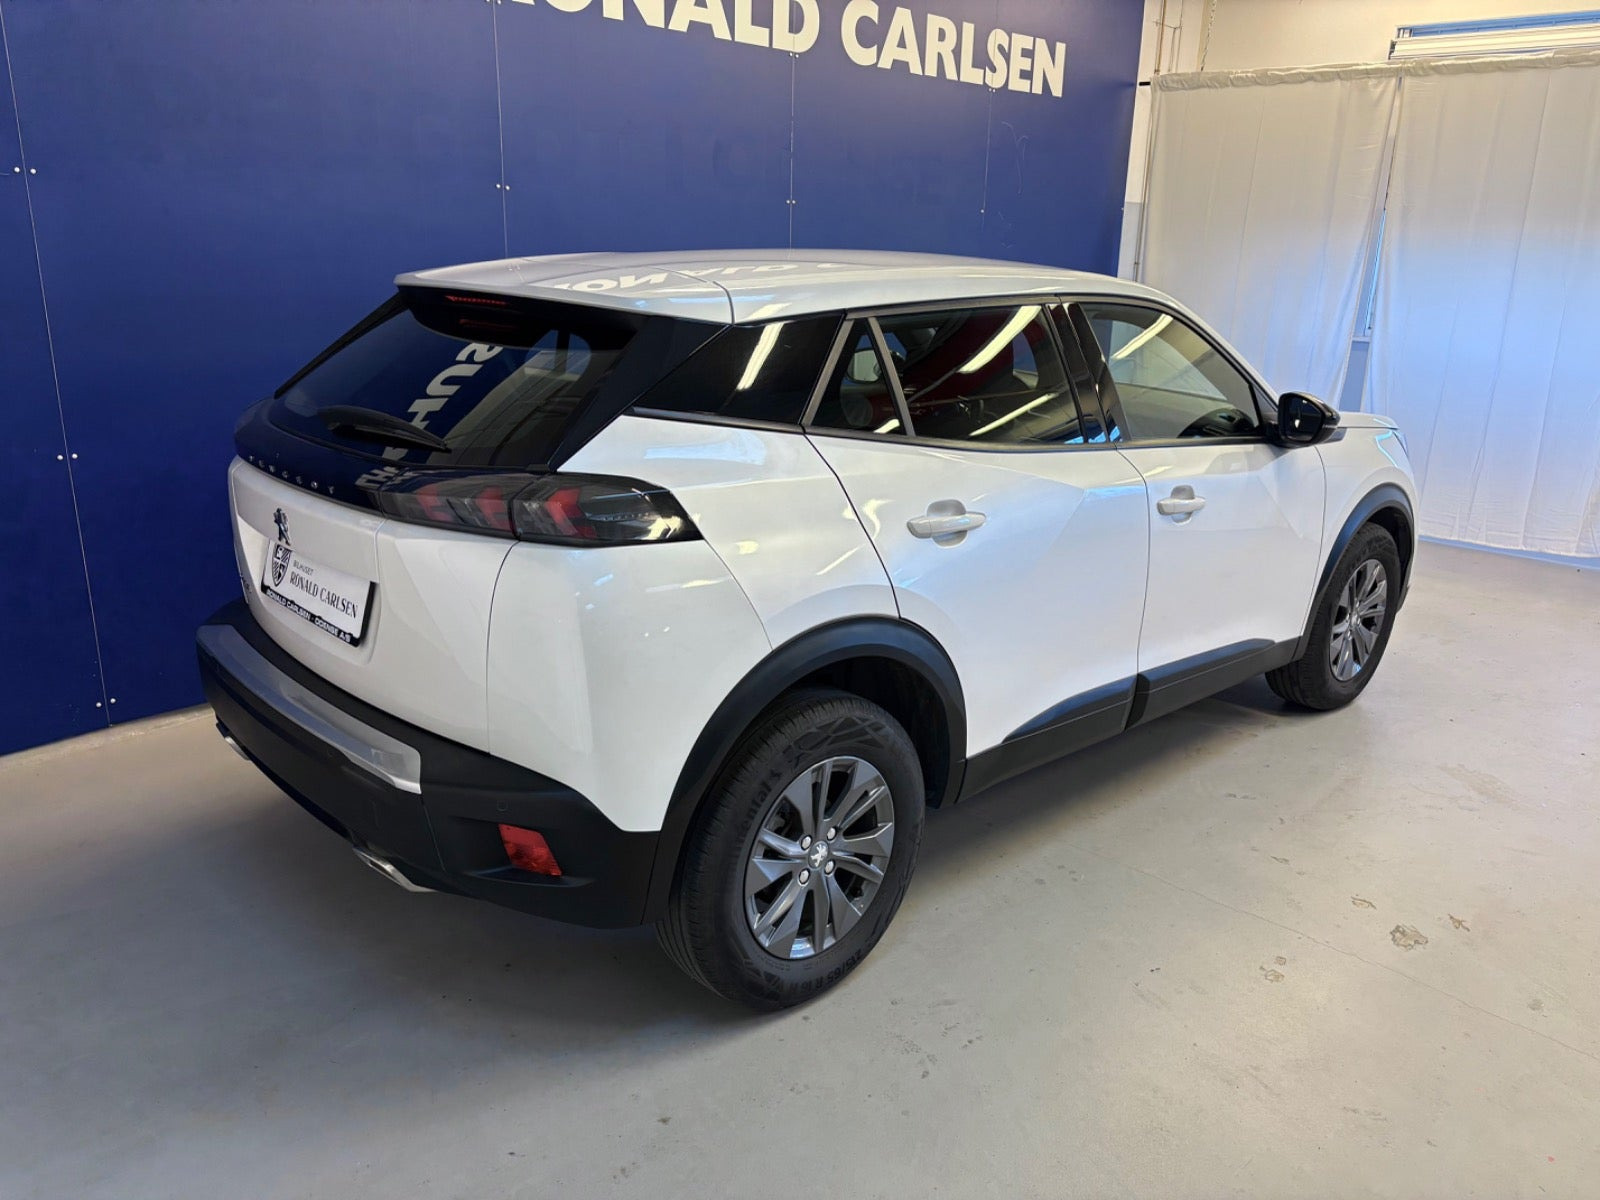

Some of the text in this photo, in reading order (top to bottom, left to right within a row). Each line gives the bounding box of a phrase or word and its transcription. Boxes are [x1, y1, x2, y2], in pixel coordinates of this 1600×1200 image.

[511, 0, 1066, 97] ALD CARLSEN
[286, 601, 311, 622] CARLSEN
[289, 571, 359, 619] RONALD CARLSEN
